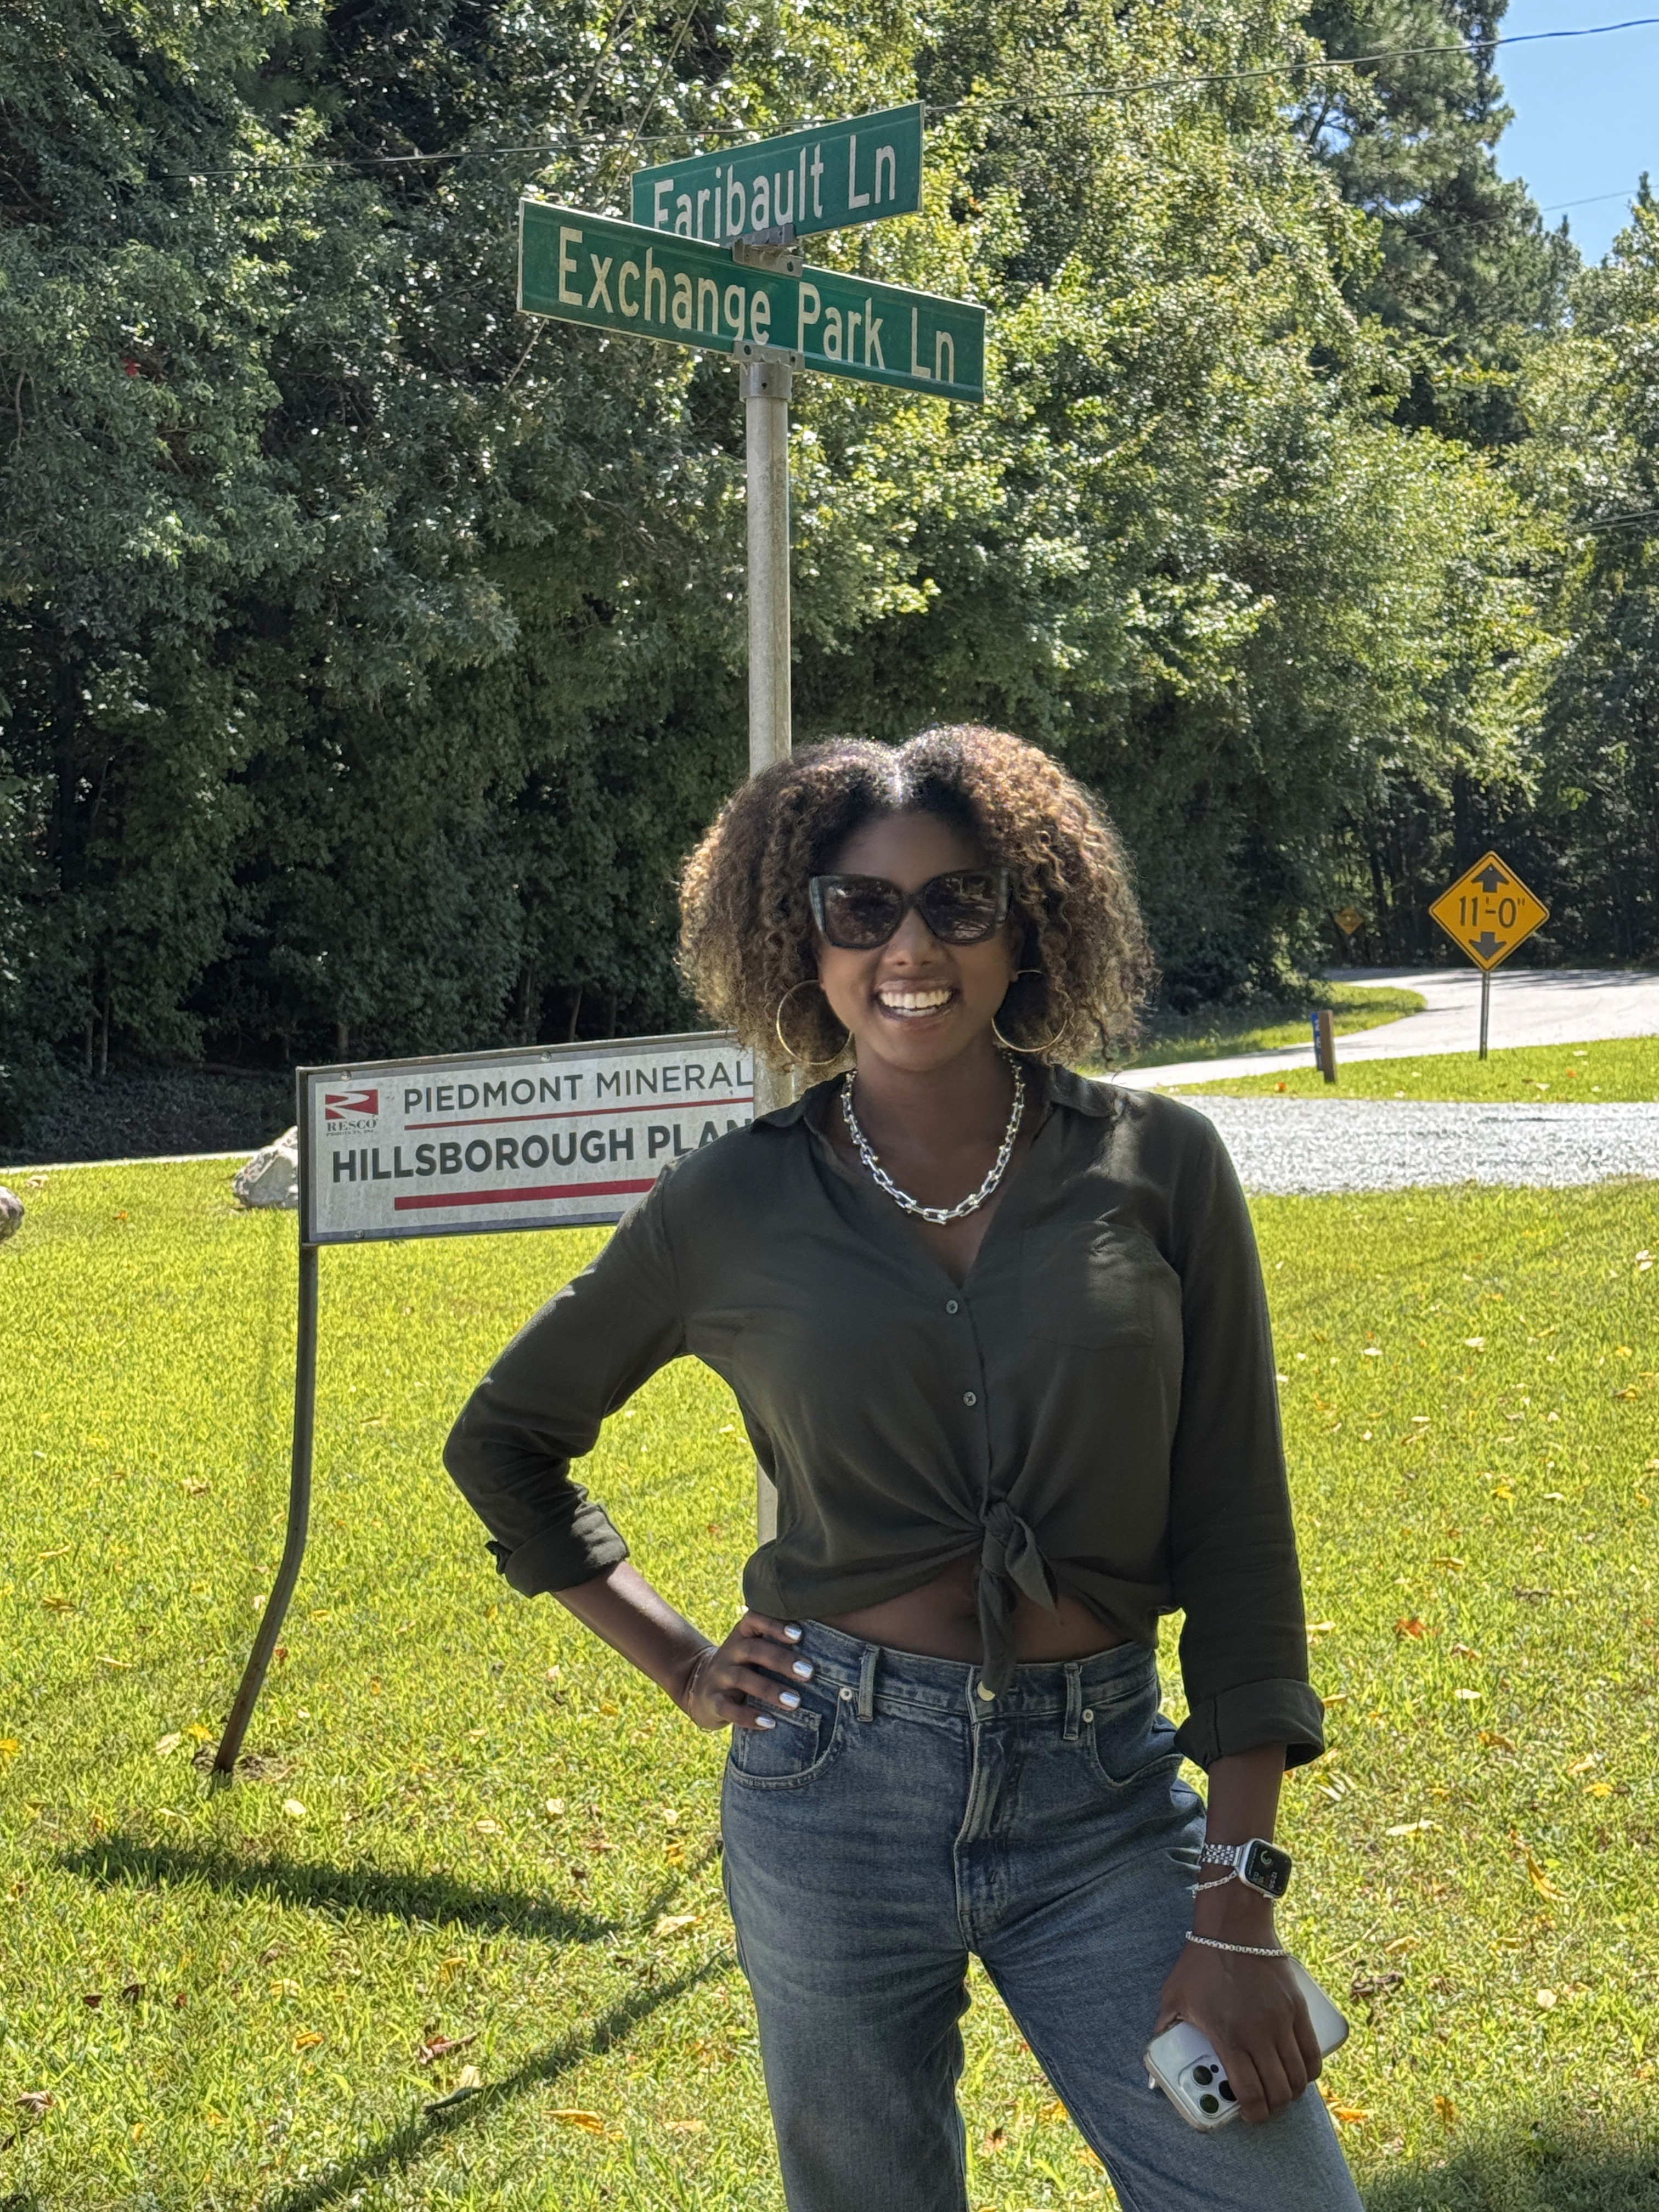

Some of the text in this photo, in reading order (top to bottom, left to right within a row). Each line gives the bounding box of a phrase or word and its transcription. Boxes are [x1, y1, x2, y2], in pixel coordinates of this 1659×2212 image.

[654, 134, 896, 239] Faribault Ln
[558, 225, 954, 383] Exchange Park Ln
[404, 1060, 753, 1114] PIEDMONT MINERAL
[328, 1119, 377, 1131] RESCO
[332, 1118, 752, 1182] HILLSBOROUGH PLA
